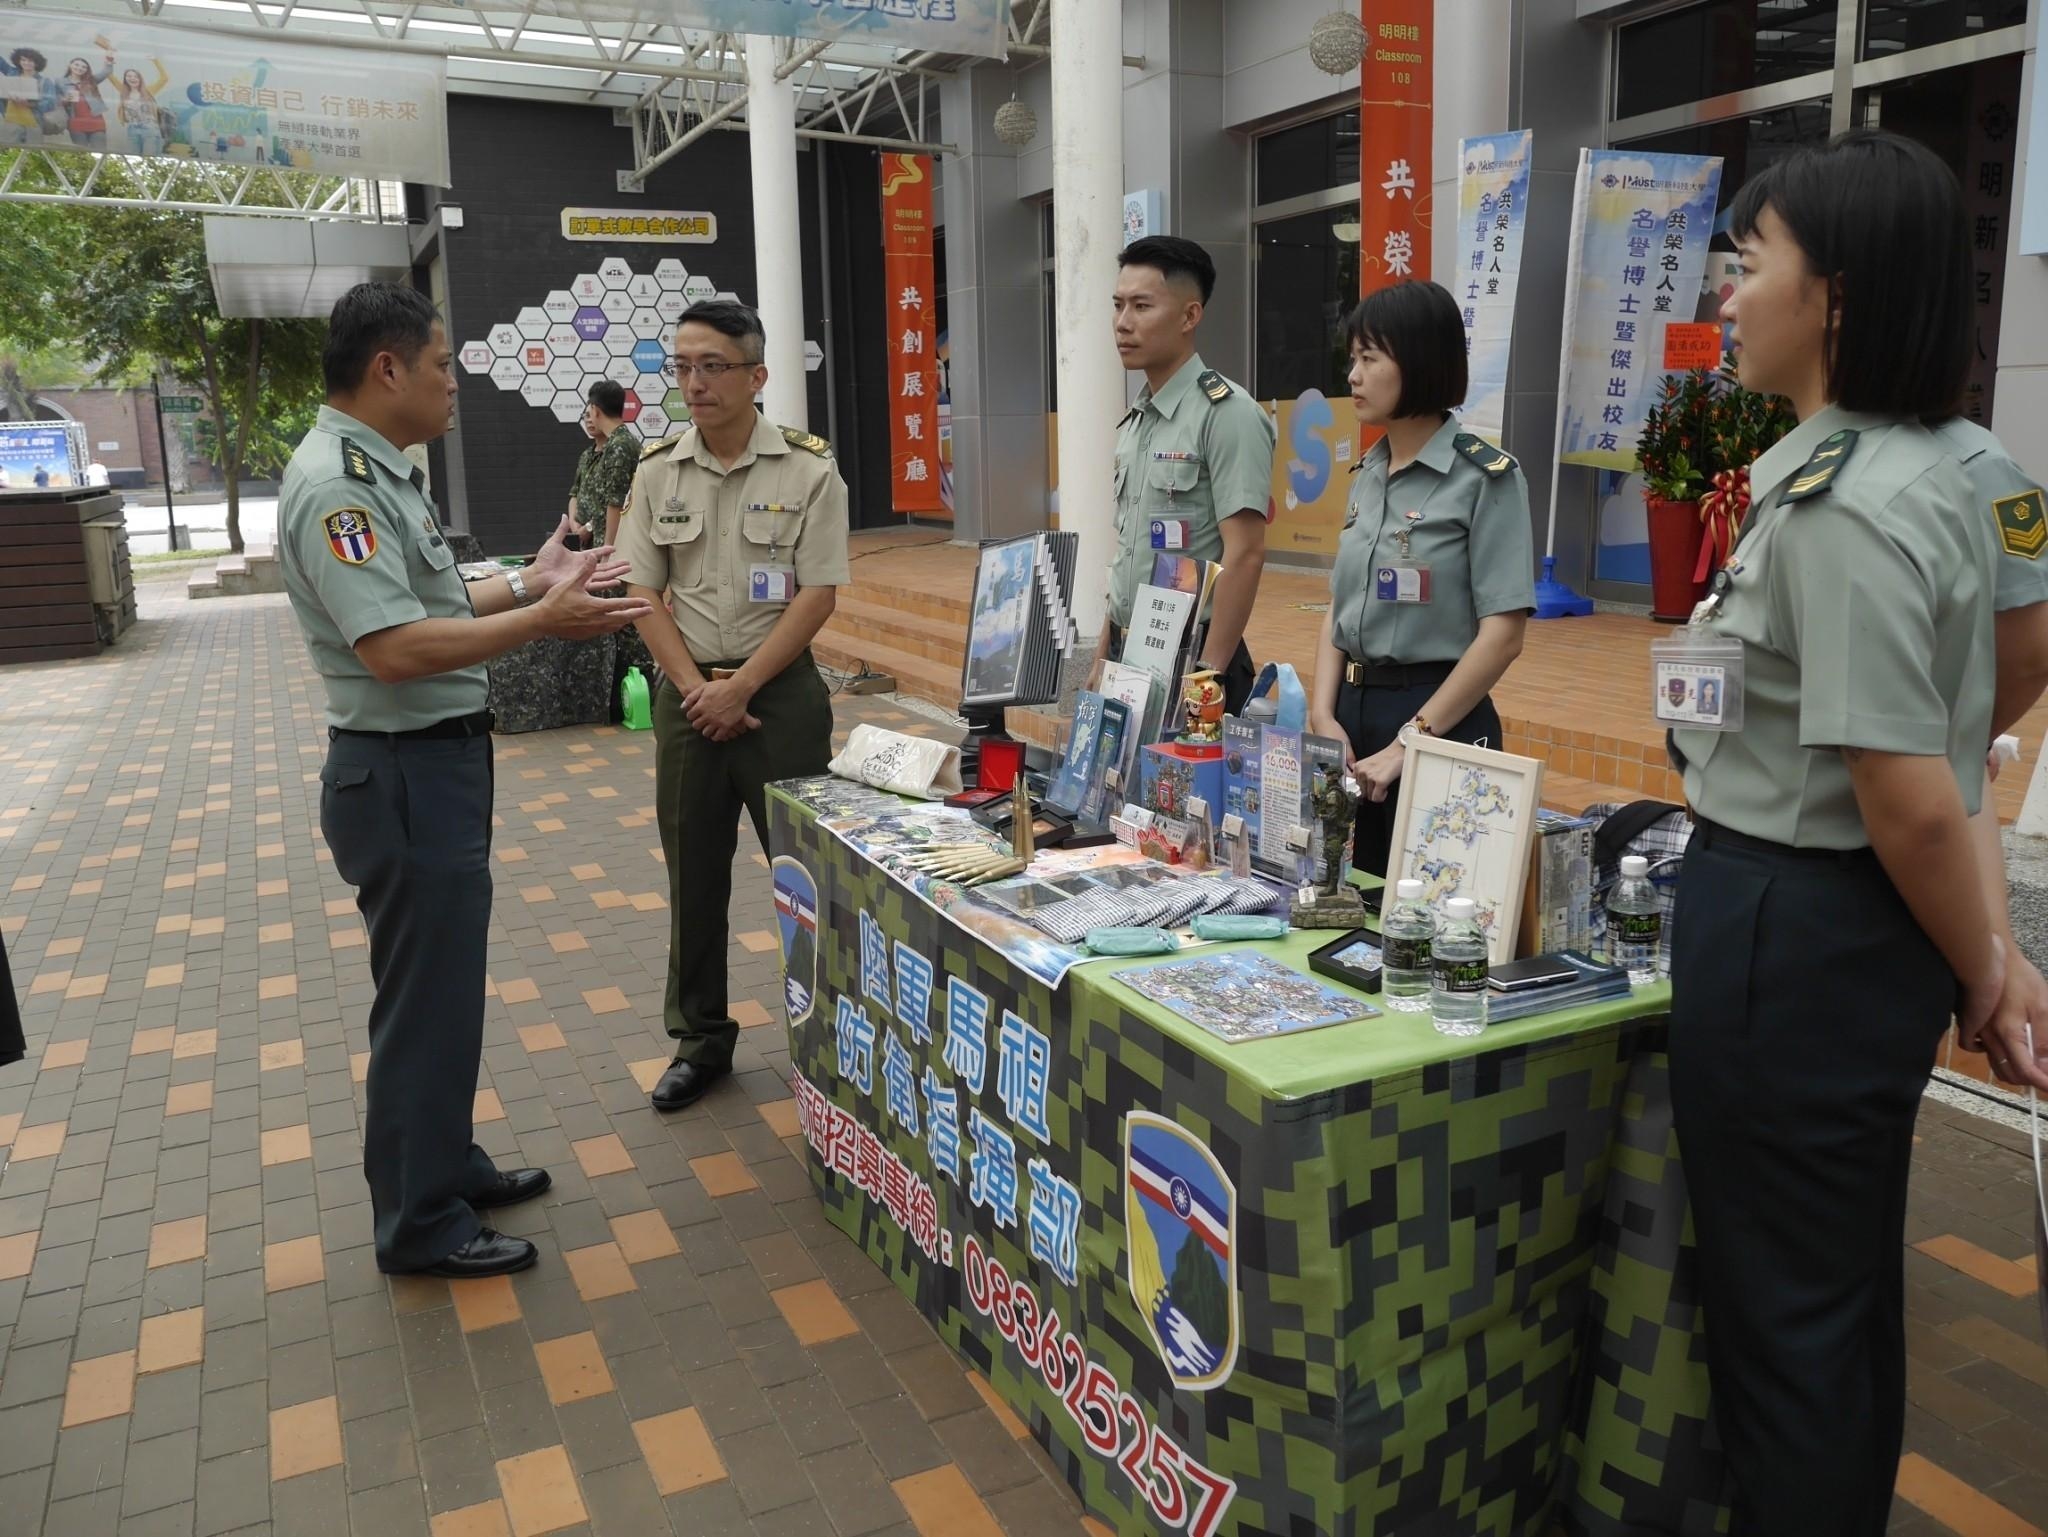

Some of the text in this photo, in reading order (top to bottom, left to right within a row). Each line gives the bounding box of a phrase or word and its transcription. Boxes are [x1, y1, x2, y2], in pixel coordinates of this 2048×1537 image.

[203, 81, 419, 121] 投資自己 行銷未來
[1375, 49, 1422, 64] Classroom
[569, 217, 710, 235] 訂單式教學合作公司
[893, 223, 927, 232] Classroom
[1485, 190, 1513, 296] 共榮名人堂
[1652, 211, 1688, 314] 共榮名人堂
[1597, 207, 1656, 452] 名譽博士暨傑出校友
[898, 286, 929, 483] 共創展覽廳
[857, 907, 1052, 1146] 陸軍馬祖
[834, 993, 1082, 1288] 防衛指揮部
[964, 1234, 1238, 1537] 083625257
